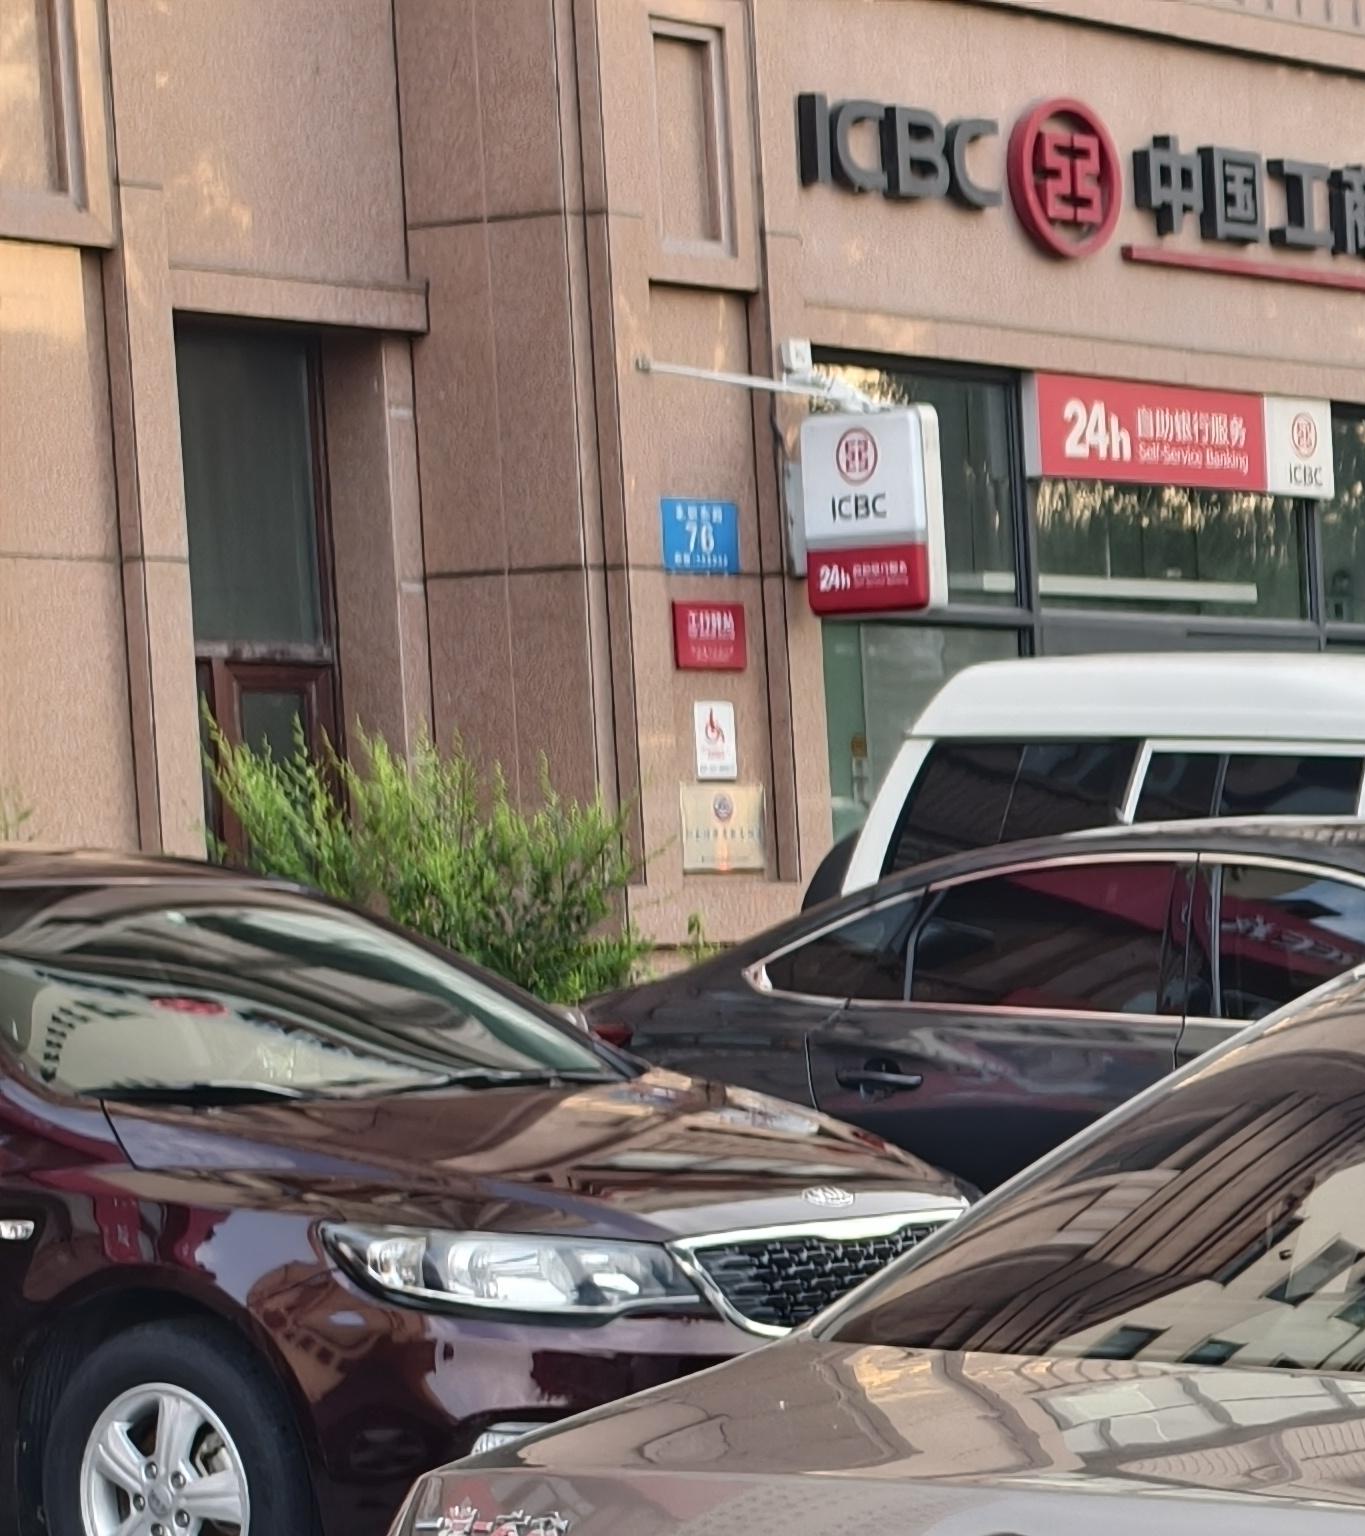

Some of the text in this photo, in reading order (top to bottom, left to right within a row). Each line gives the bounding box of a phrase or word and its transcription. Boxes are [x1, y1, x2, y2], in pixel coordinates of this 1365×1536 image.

[796, 93, 1001, 208] ICBC
[1063, 397, 1132, 463] 24h
[1136, 405, 1247, 448] 自助银行服务
[1288, 463, 1323, 488] ICBC
[831, 493, 888, 523] ICBC
[819, 564, 851, 593] 24h
